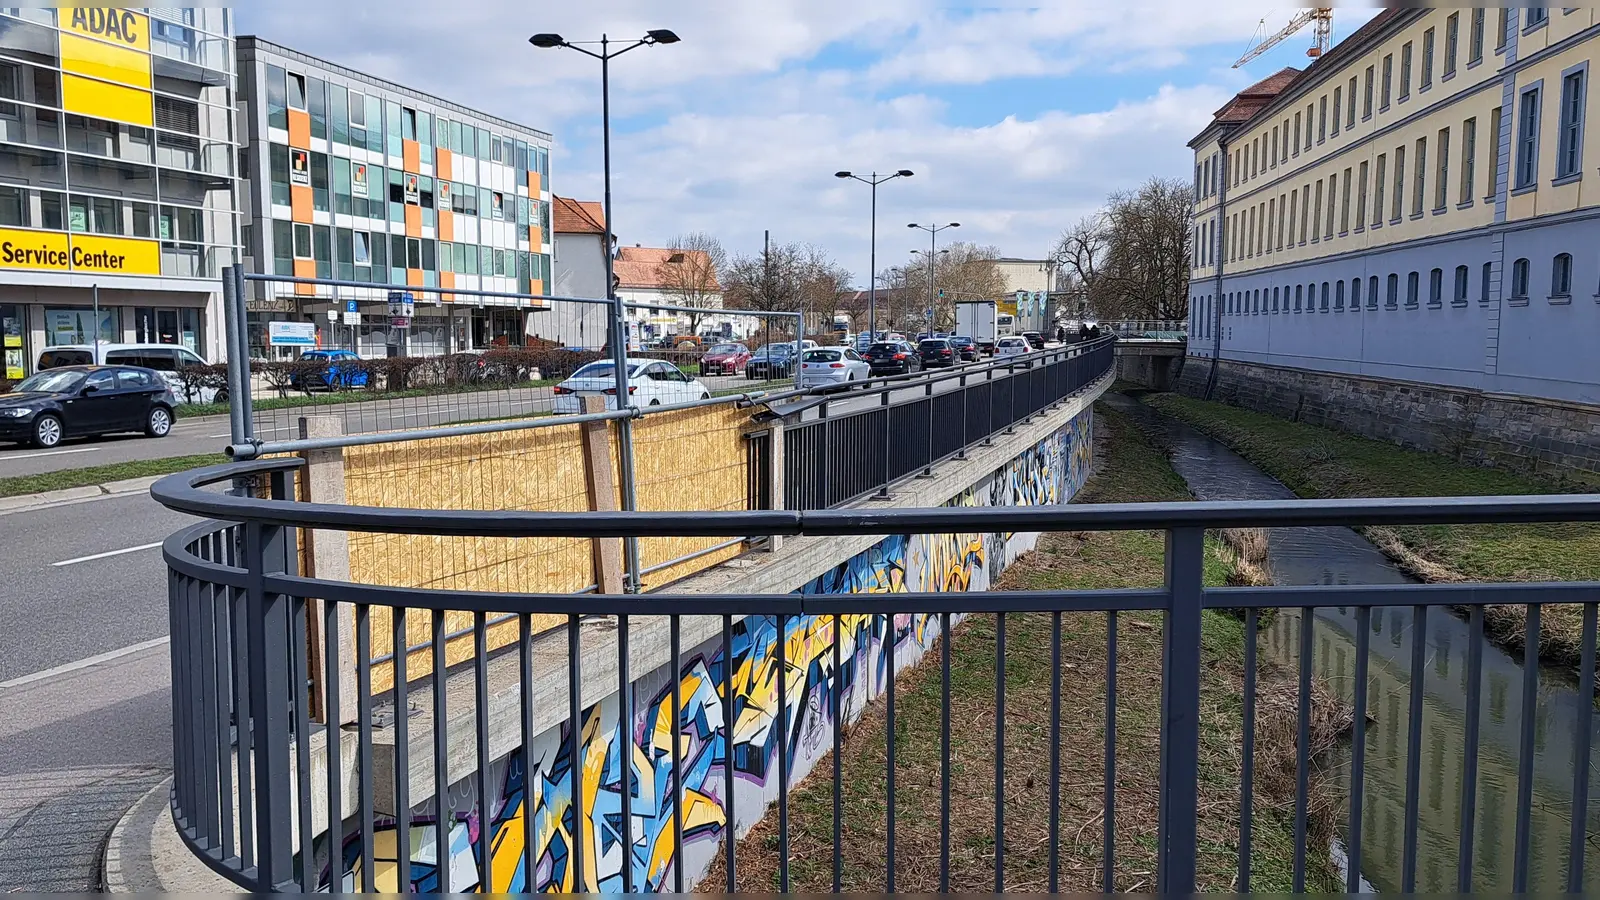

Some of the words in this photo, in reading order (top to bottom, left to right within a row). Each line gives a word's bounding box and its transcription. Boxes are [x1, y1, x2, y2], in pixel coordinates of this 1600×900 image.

[71, 8, 137, 43] ADAC
[2, 241, 67, 266] Service
[72, 247, 125, 269] Center
